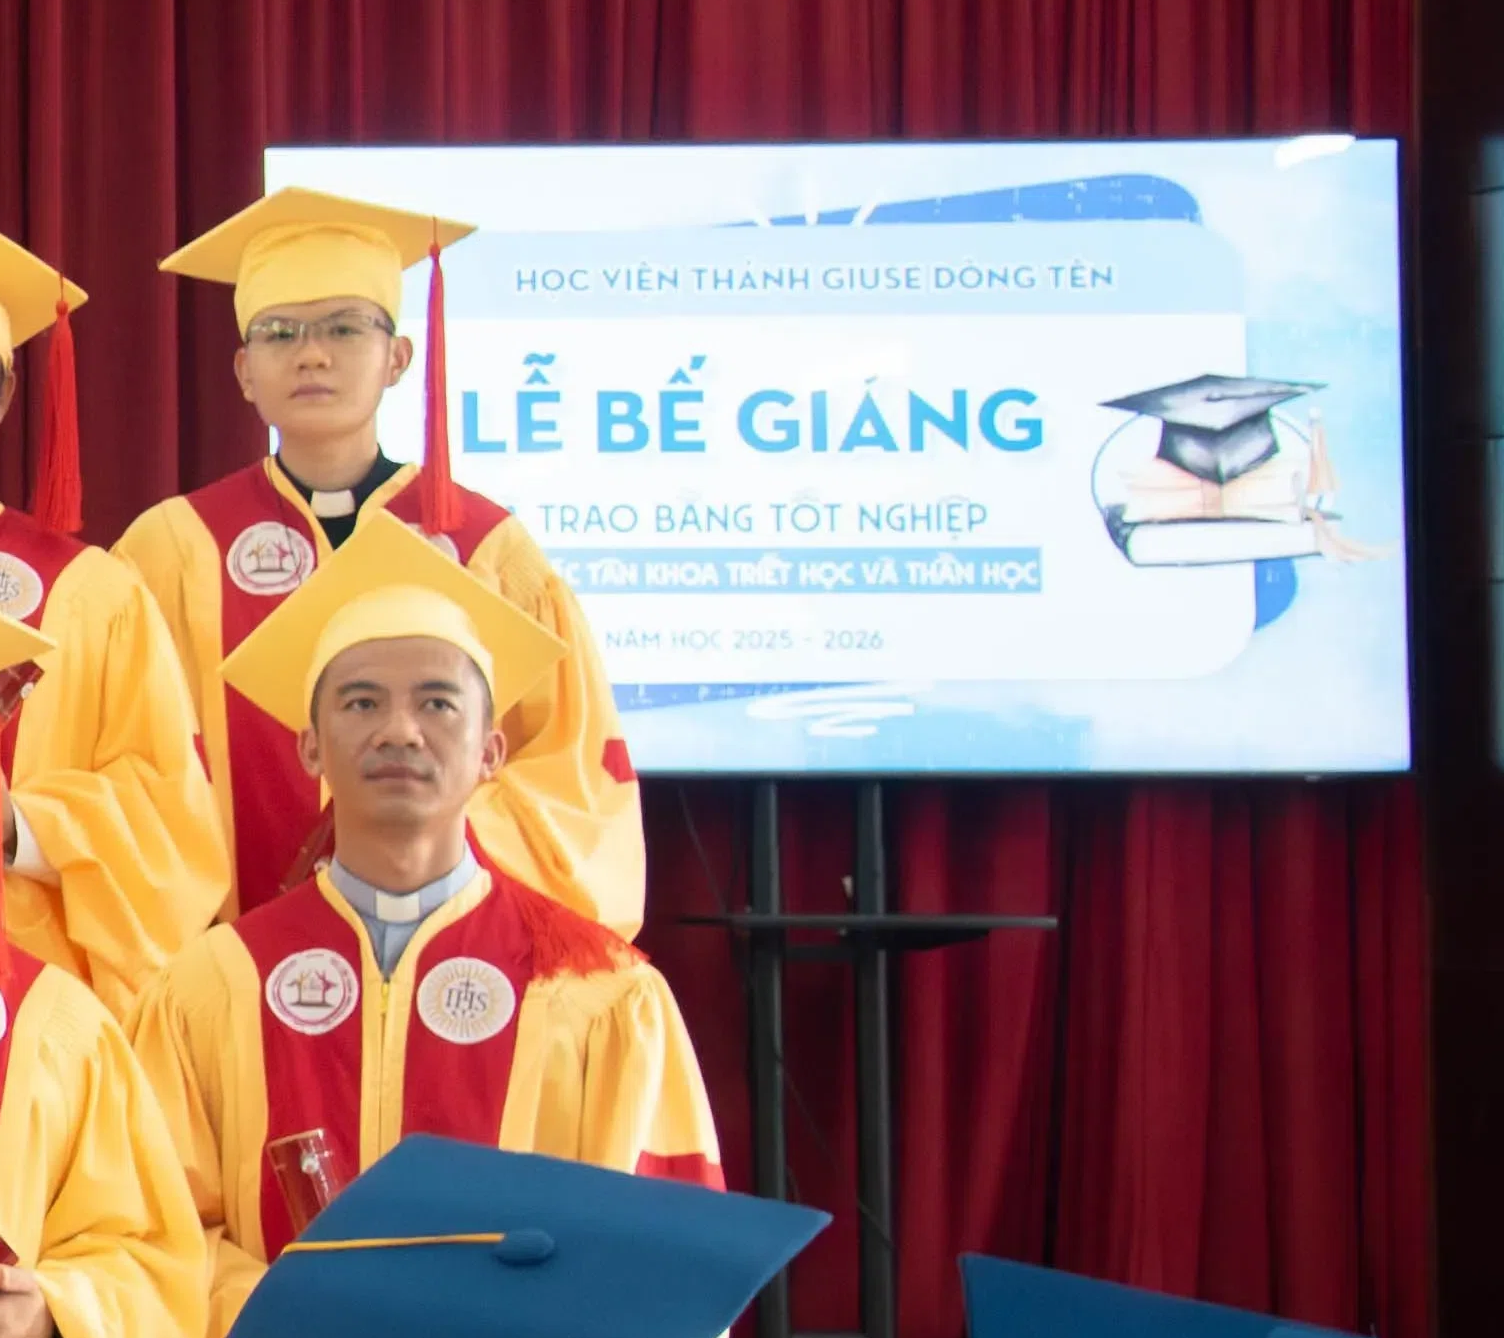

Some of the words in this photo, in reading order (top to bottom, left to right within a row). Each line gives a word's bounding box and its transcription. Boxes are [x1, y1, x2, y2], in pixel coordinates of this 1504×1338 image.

[822, 267, 921, 289] GIUSE
[1048, 258, 1113, 288] TÊN
[461, 353, 562, 454] LỄ
[596, 354, 708, 454] BẾ
[537, 504, 639, 533] TRAO
[645, 562, 720, 586] KHOA
[799, 562, 855, 591] HỌC
[861, 556, 899, 586] VÀ
[982, 561, 1038, 591] HỌC
[732, 629, 794, 650] 2025
[824, 629, 885, 650] 2026
